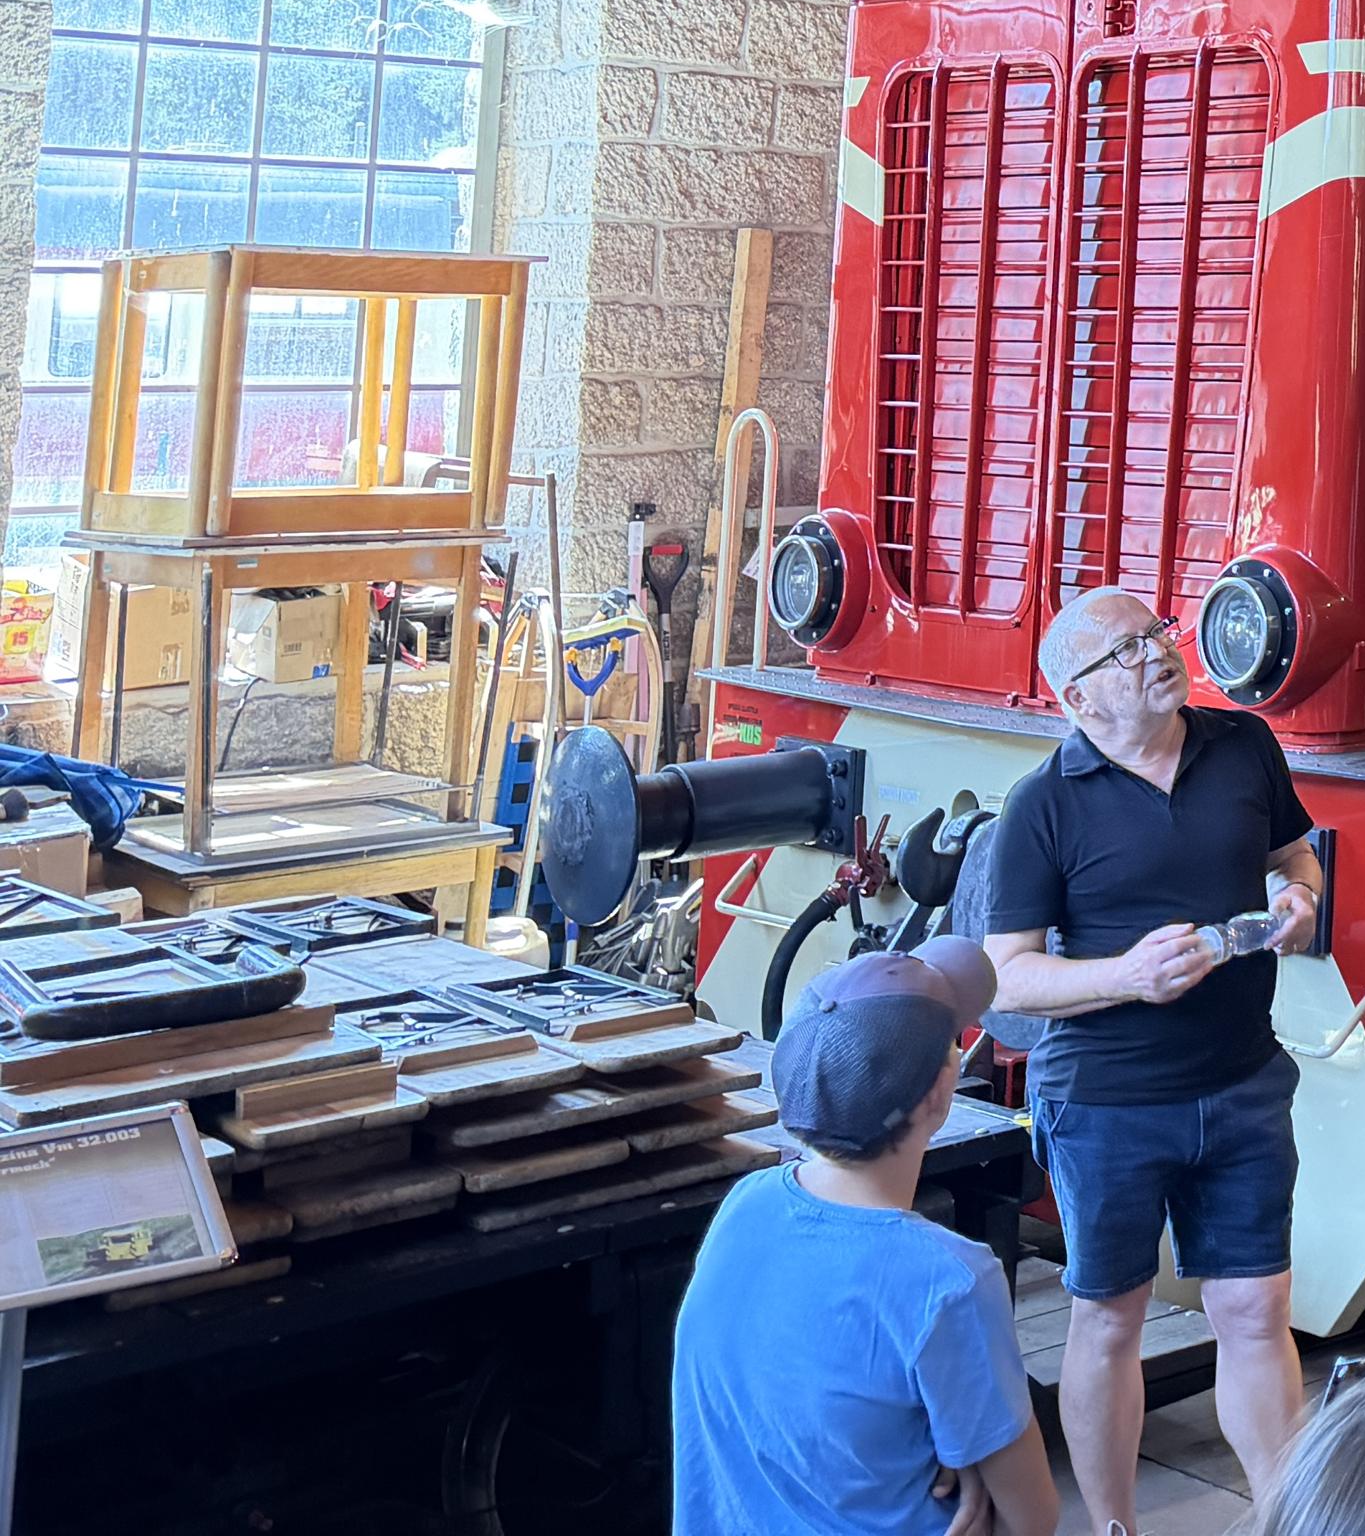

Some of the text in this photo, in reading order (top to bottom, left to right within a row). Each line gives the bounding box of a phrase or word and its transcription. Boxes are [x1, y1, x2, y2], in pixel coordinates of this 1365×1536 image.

[11, 631, 29, 647] 15
[42, 1142, 74, 1154] Vm
[77, 1128, 140, 1148] 32.003
